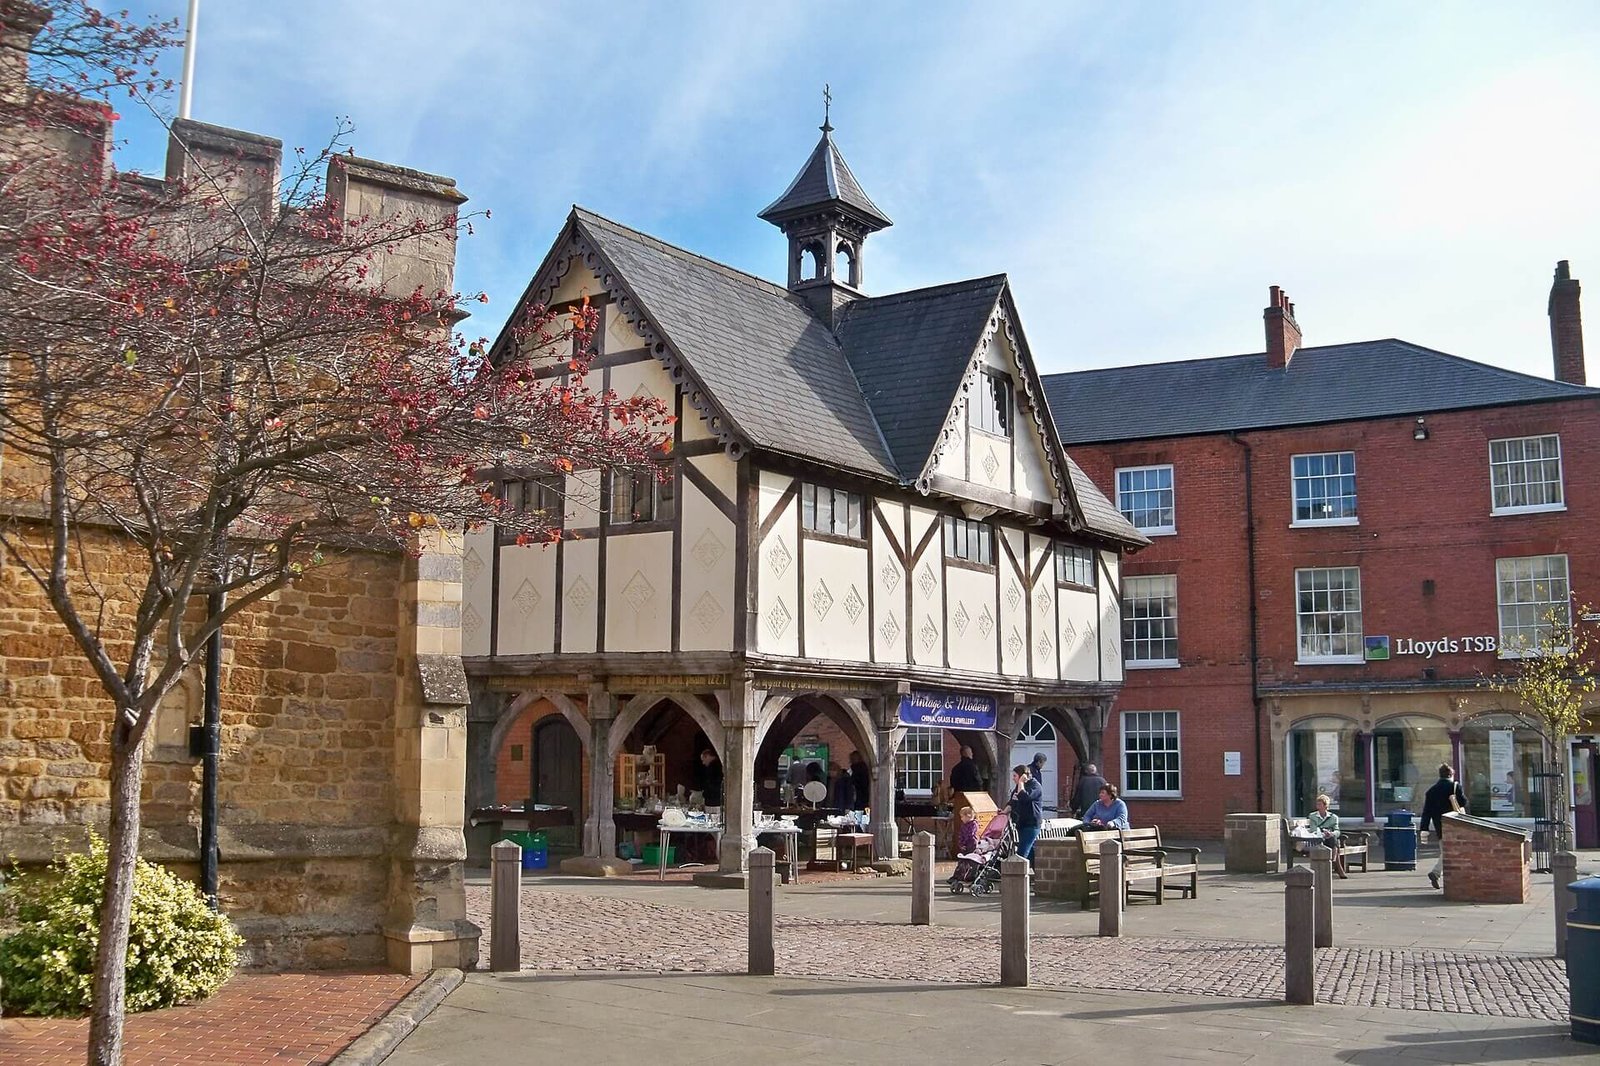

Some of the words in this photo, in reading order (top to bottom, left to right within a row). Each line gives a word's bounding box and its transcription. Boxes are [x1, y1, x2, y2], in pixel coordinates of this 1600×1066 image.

[1396, 637, 1459, 659] Lloyds
[1461, 636, 1497, 653] TSB
[911, 691, 942, 714] Vintage
[945, 695, 955, 709] &
[956, 695, 990, 713] Modern
